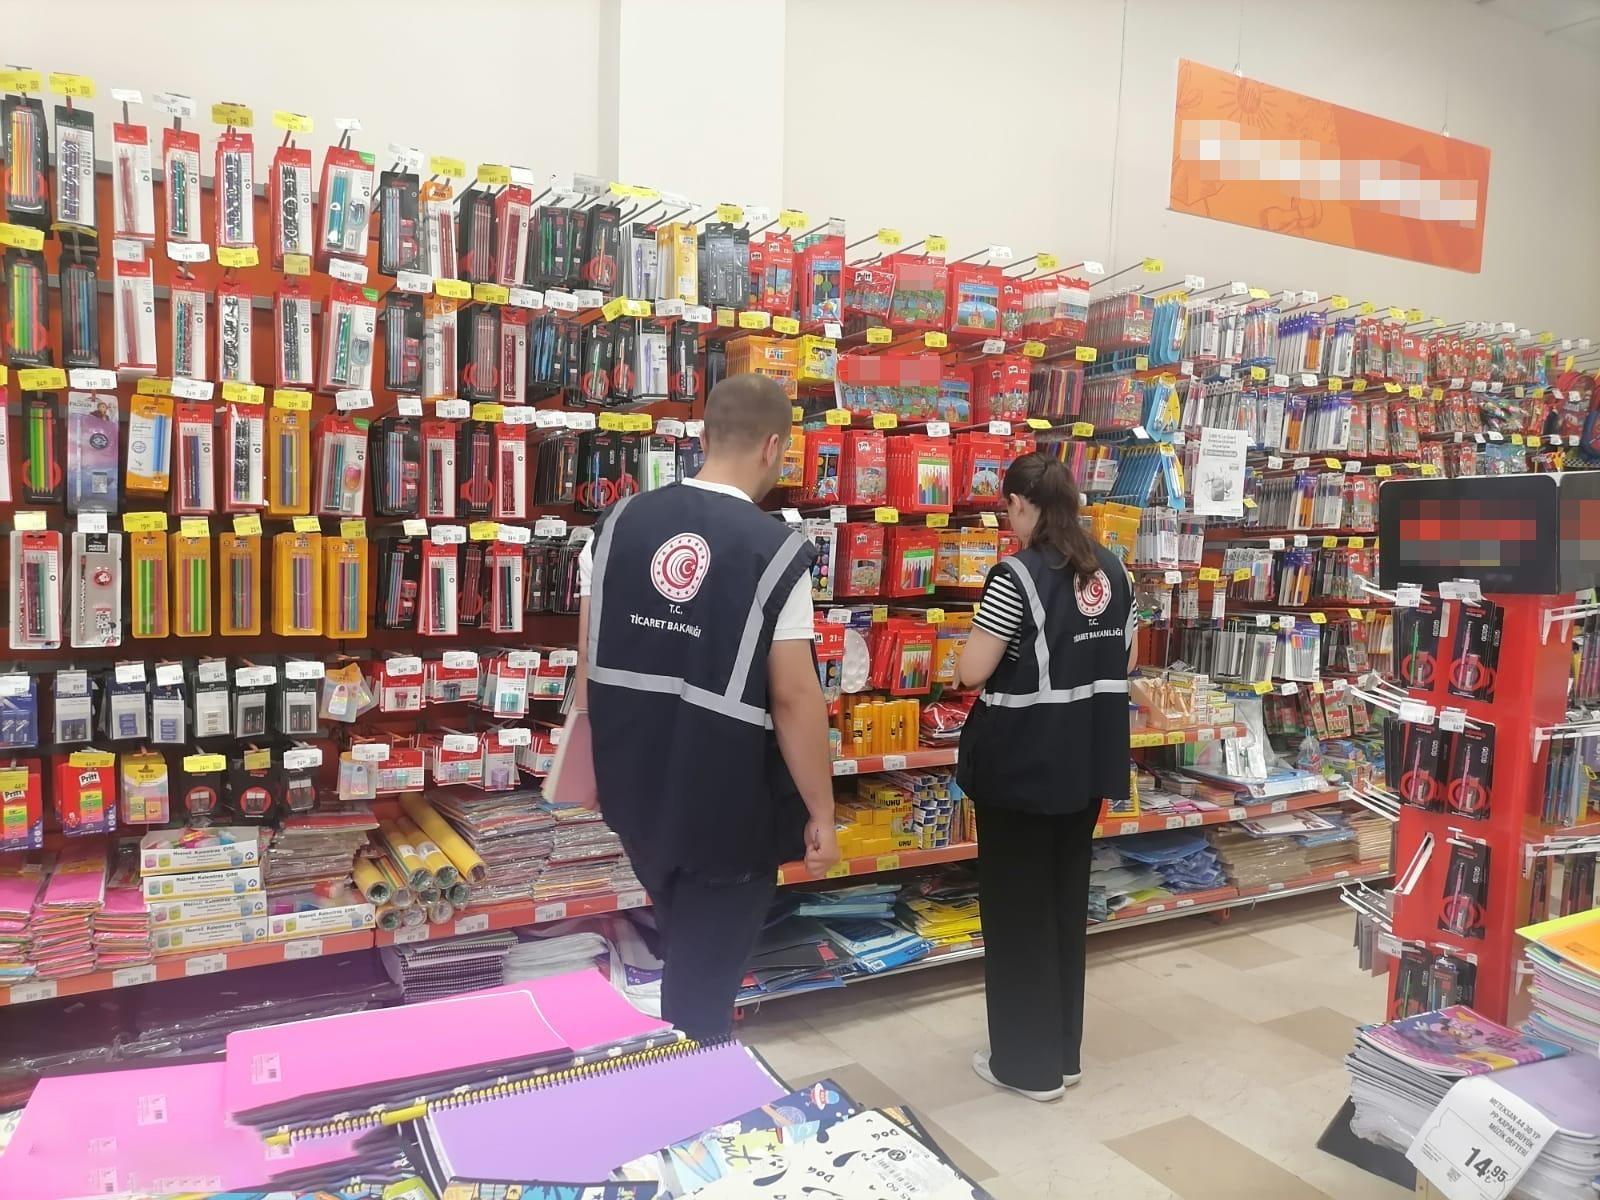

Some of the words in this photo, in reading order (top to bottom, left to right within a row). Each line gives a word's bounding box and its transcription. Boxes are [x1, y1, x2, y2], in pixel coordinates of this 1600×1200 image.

[669, 603, 683, 615] T.C.
[630, 613, 667, 630] TİCARET
[80, 772, 98, 783] Pritt
[885, 799, 901, 807] UHU
[1489, 1097, 1518, 1122] METEKSAN
[1515, 1118, 1526, 1128] A4
[871, 1128, 900, 1141] DOG
[1490, 1110, 1499, 1119] PP
[1496, 1116, 1517, 1135] KAPAK
[1514, 1130, 1534, 1150] BÜYÜK
[1488, 1122, 1506, 1140] MÜZİK
[1504, 1136, 1529, 1158] DEFTERİ
[807, 1166, 835, 1183] DOG
